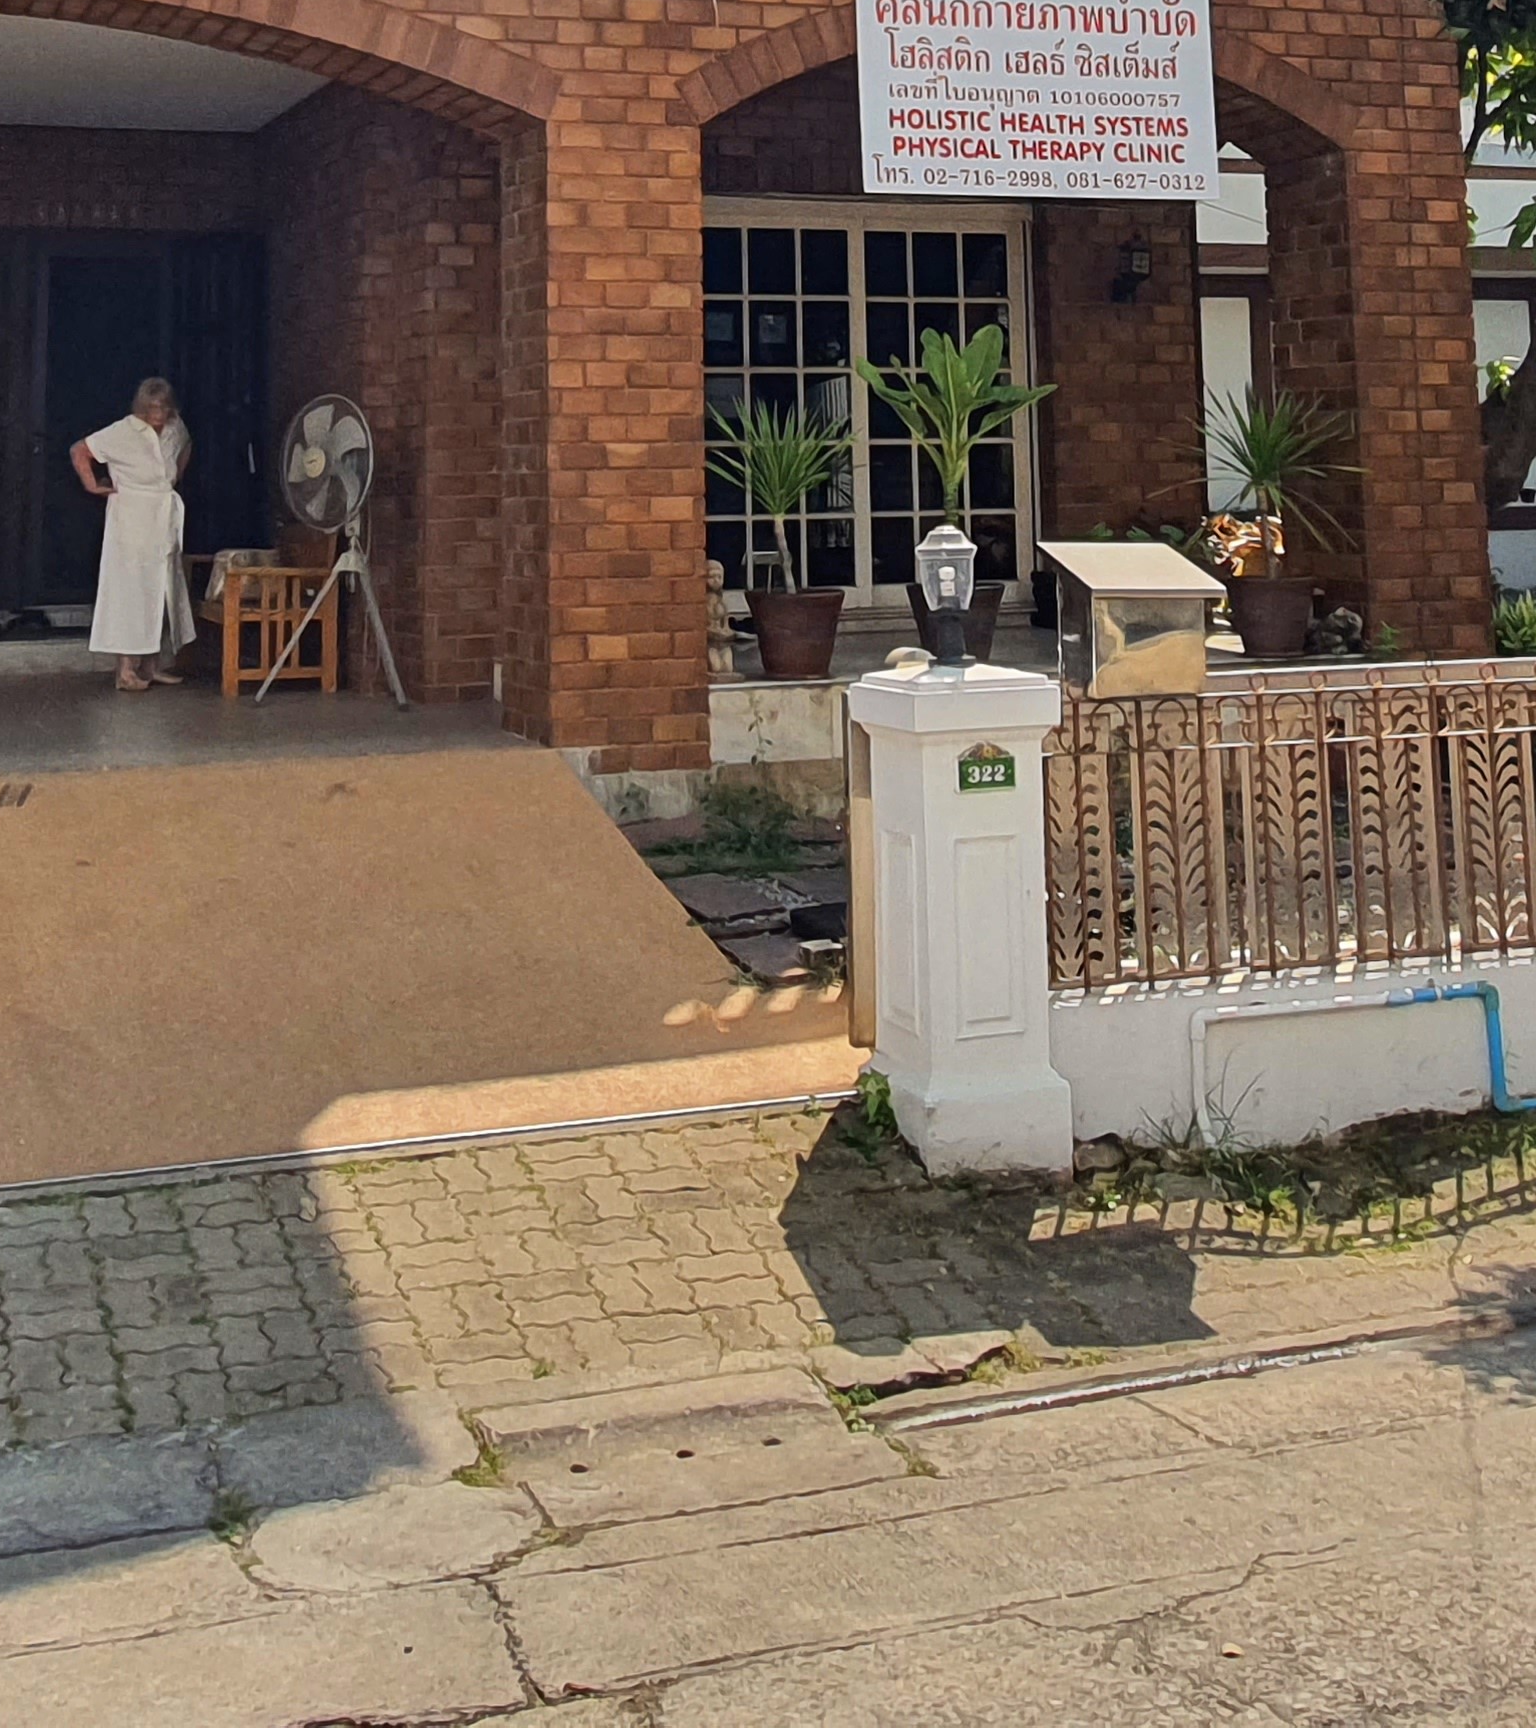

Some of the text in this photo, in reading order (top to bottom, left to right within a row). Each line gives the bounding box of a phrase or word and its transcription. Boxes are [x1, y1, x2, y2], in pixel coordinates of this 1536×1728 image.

[884, 27, 1178, 79] โฮลิสติก เฮลธ์ ซิสเต็มส์
[889, 72, 1180, 110] เลขที่ใบอนุญาต 10106000757
[888, 108, 1190, 138] HOLISTIC HEALTH SYSTEMS
[892, 135, 1186, 164] PHYSICAL THERAPY CLINIC
[871, 153, 1205, 191] โทร. 02-716-2998, 081-627-0312
[967, 764, 1006, 784] 322
